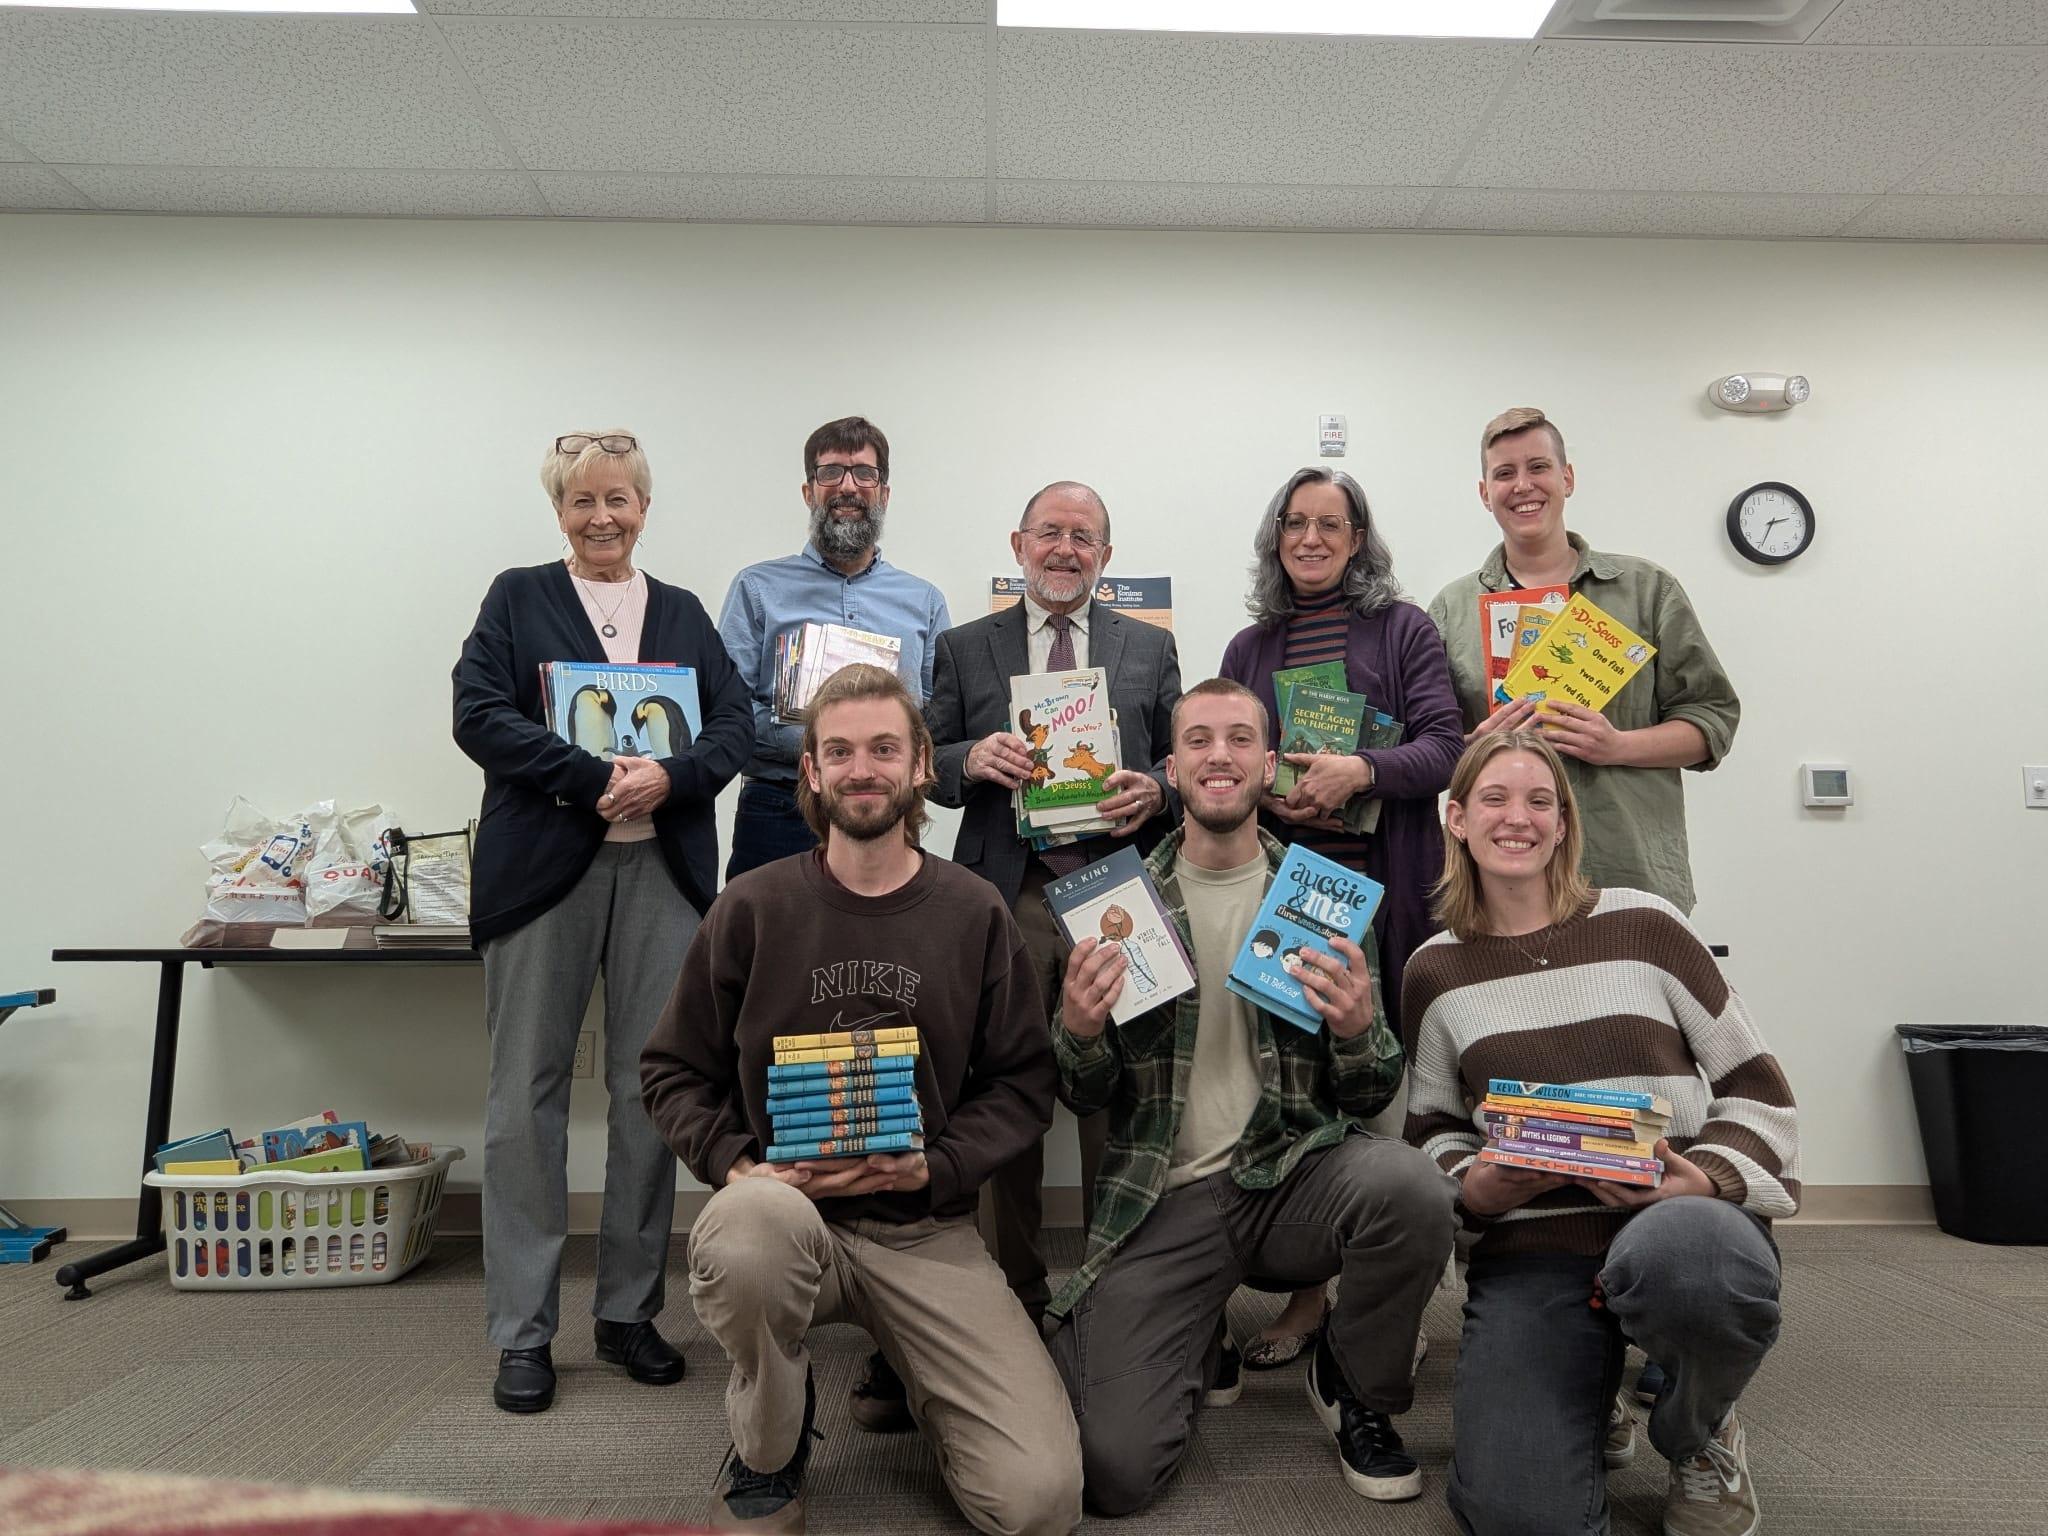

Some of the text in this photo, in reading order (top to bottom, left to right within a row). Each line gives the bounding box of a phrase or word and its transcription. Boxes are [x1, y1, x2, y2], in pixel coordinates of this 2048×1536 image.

[1324, 431, 1343, 439] FIRE
[1753, 496, 1760, 505] 11
[1765, 491, 1775, 502] 12
[1744, 506, 1755, 516] 10
[1770, 545, 1776, 553] 6
[1498, 618, 1517, 638] Fo
[1571, 606, 1622, 649] By Dr. Seuss
[1592, 648, 1608, 665] One
[1608, 660, 1625, 676] fish
[595, 672, 658, 692] BIRDS
[1579, 668, 1610, 695] two fish
[1044, 694, 1069, 706] Brown
[1563, 683, 1591, 708] red fish
[1044, 707, 1059, 715] Can
[1052, 693, 1095, 733] MOO!
[1319, 704, 1336, 713] THE
[1293, 717, 1355, 735] ON FLIGHT 101
[1295, 708, 1355, 727] SECRET AGENT
[1051, 780, 1092, 792] Dr. Seuss's
[1054, 880, 1078, 896] A.S.
[1080, 864, 1109, 884] KING
[275, 894, 300, 902] you
[1287, 885, 1309, 909] &
[1277, 905, 1298, 922] three
[811, 960, 921, 1007] NIKE
[1496, 1081, 1522, 1093] KEVIN
[1536, 1086, 1571, 1098] WILSON
[1521, 1130, 1541, 1140] MYTHS
[1546, 1134, 1571, 1144] LEGENDS
[1494, 1154, 1514, 1162] GREY
[1525, 1158, 1594, 1175] RATED
